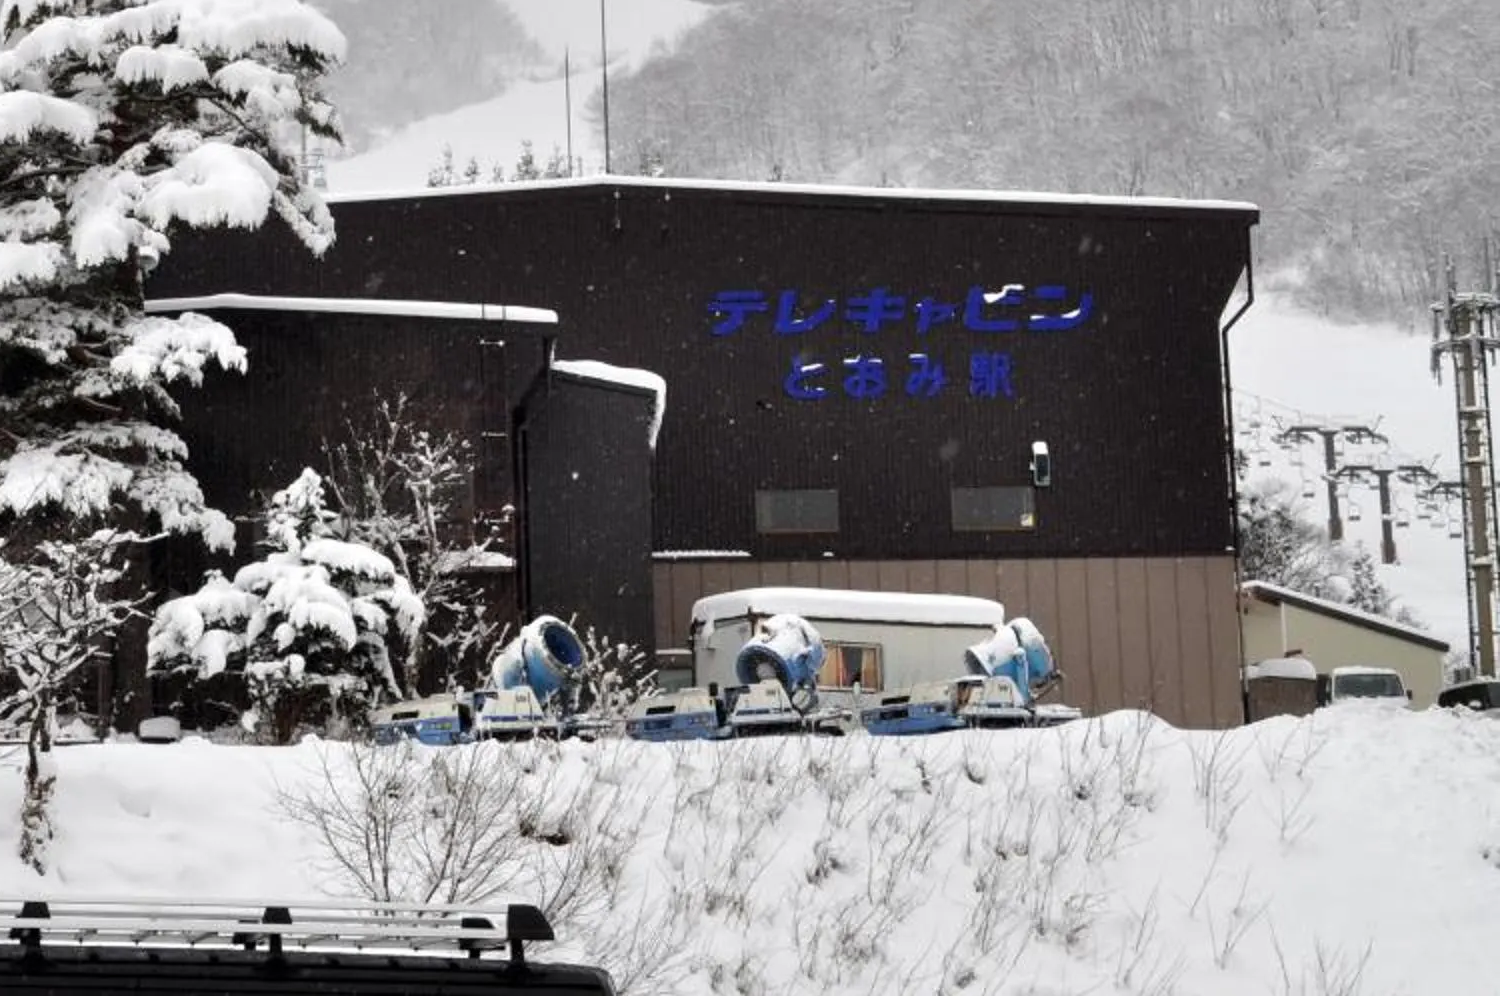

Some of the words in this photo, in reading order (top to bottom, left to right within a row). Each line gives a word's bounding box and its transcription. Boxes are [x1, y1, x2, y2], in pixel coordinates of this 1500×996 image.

[708, 284, 1093, 334] テレキャビン
